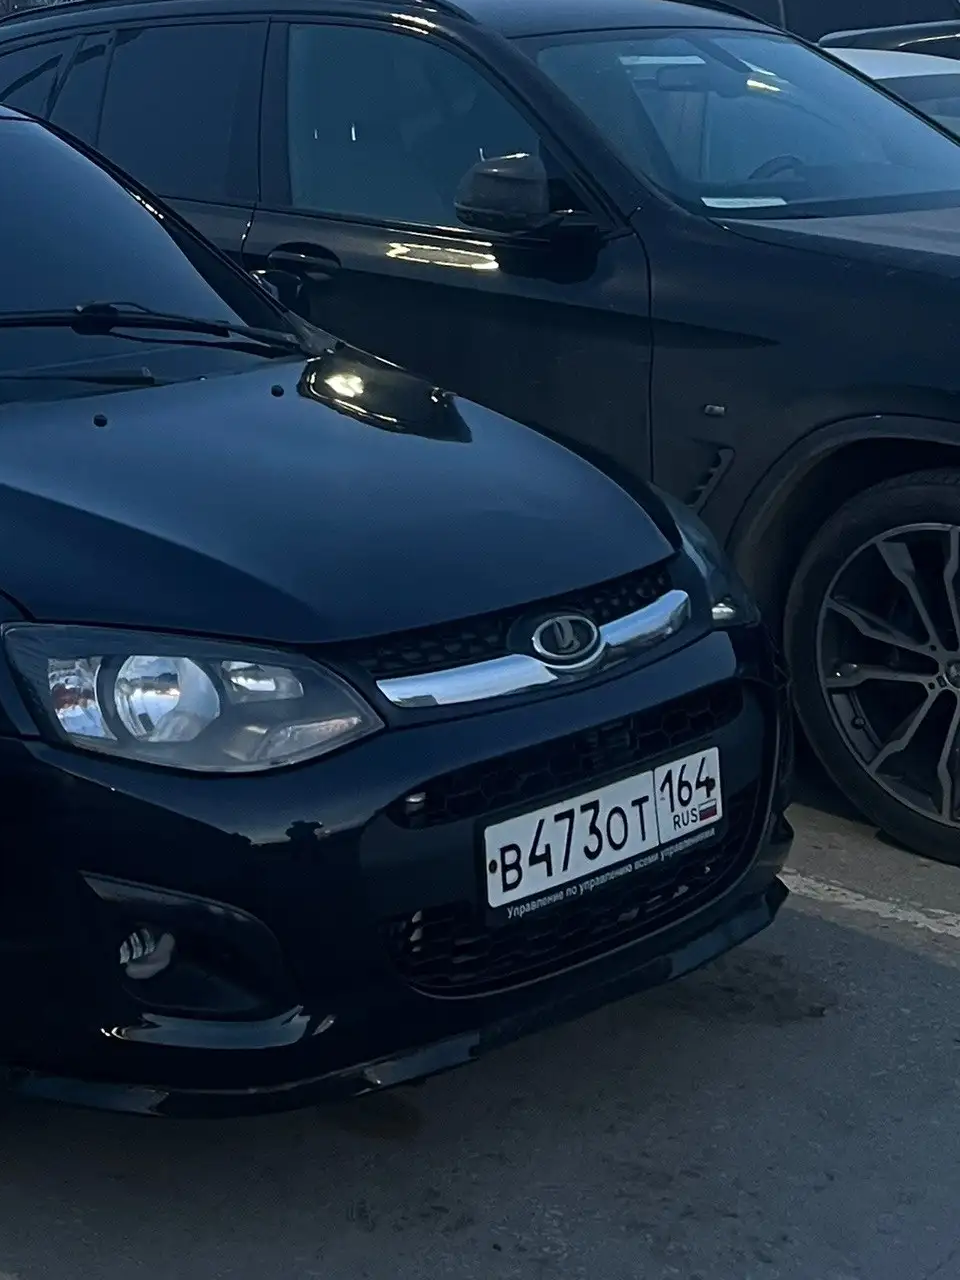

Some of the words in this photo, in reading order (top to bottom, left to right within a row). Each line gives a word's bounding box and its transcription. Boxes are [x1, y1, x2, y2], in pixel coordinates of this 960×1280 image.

[660, 756, 714, 813] 164
[499, 795, 650, 893] В473ОТ
[673, 807, 699, 831] RUS
[507, 890, 564, 919] Управление
[566, 885, 577, 897] по
[579, 864, 632, 895] управлению
